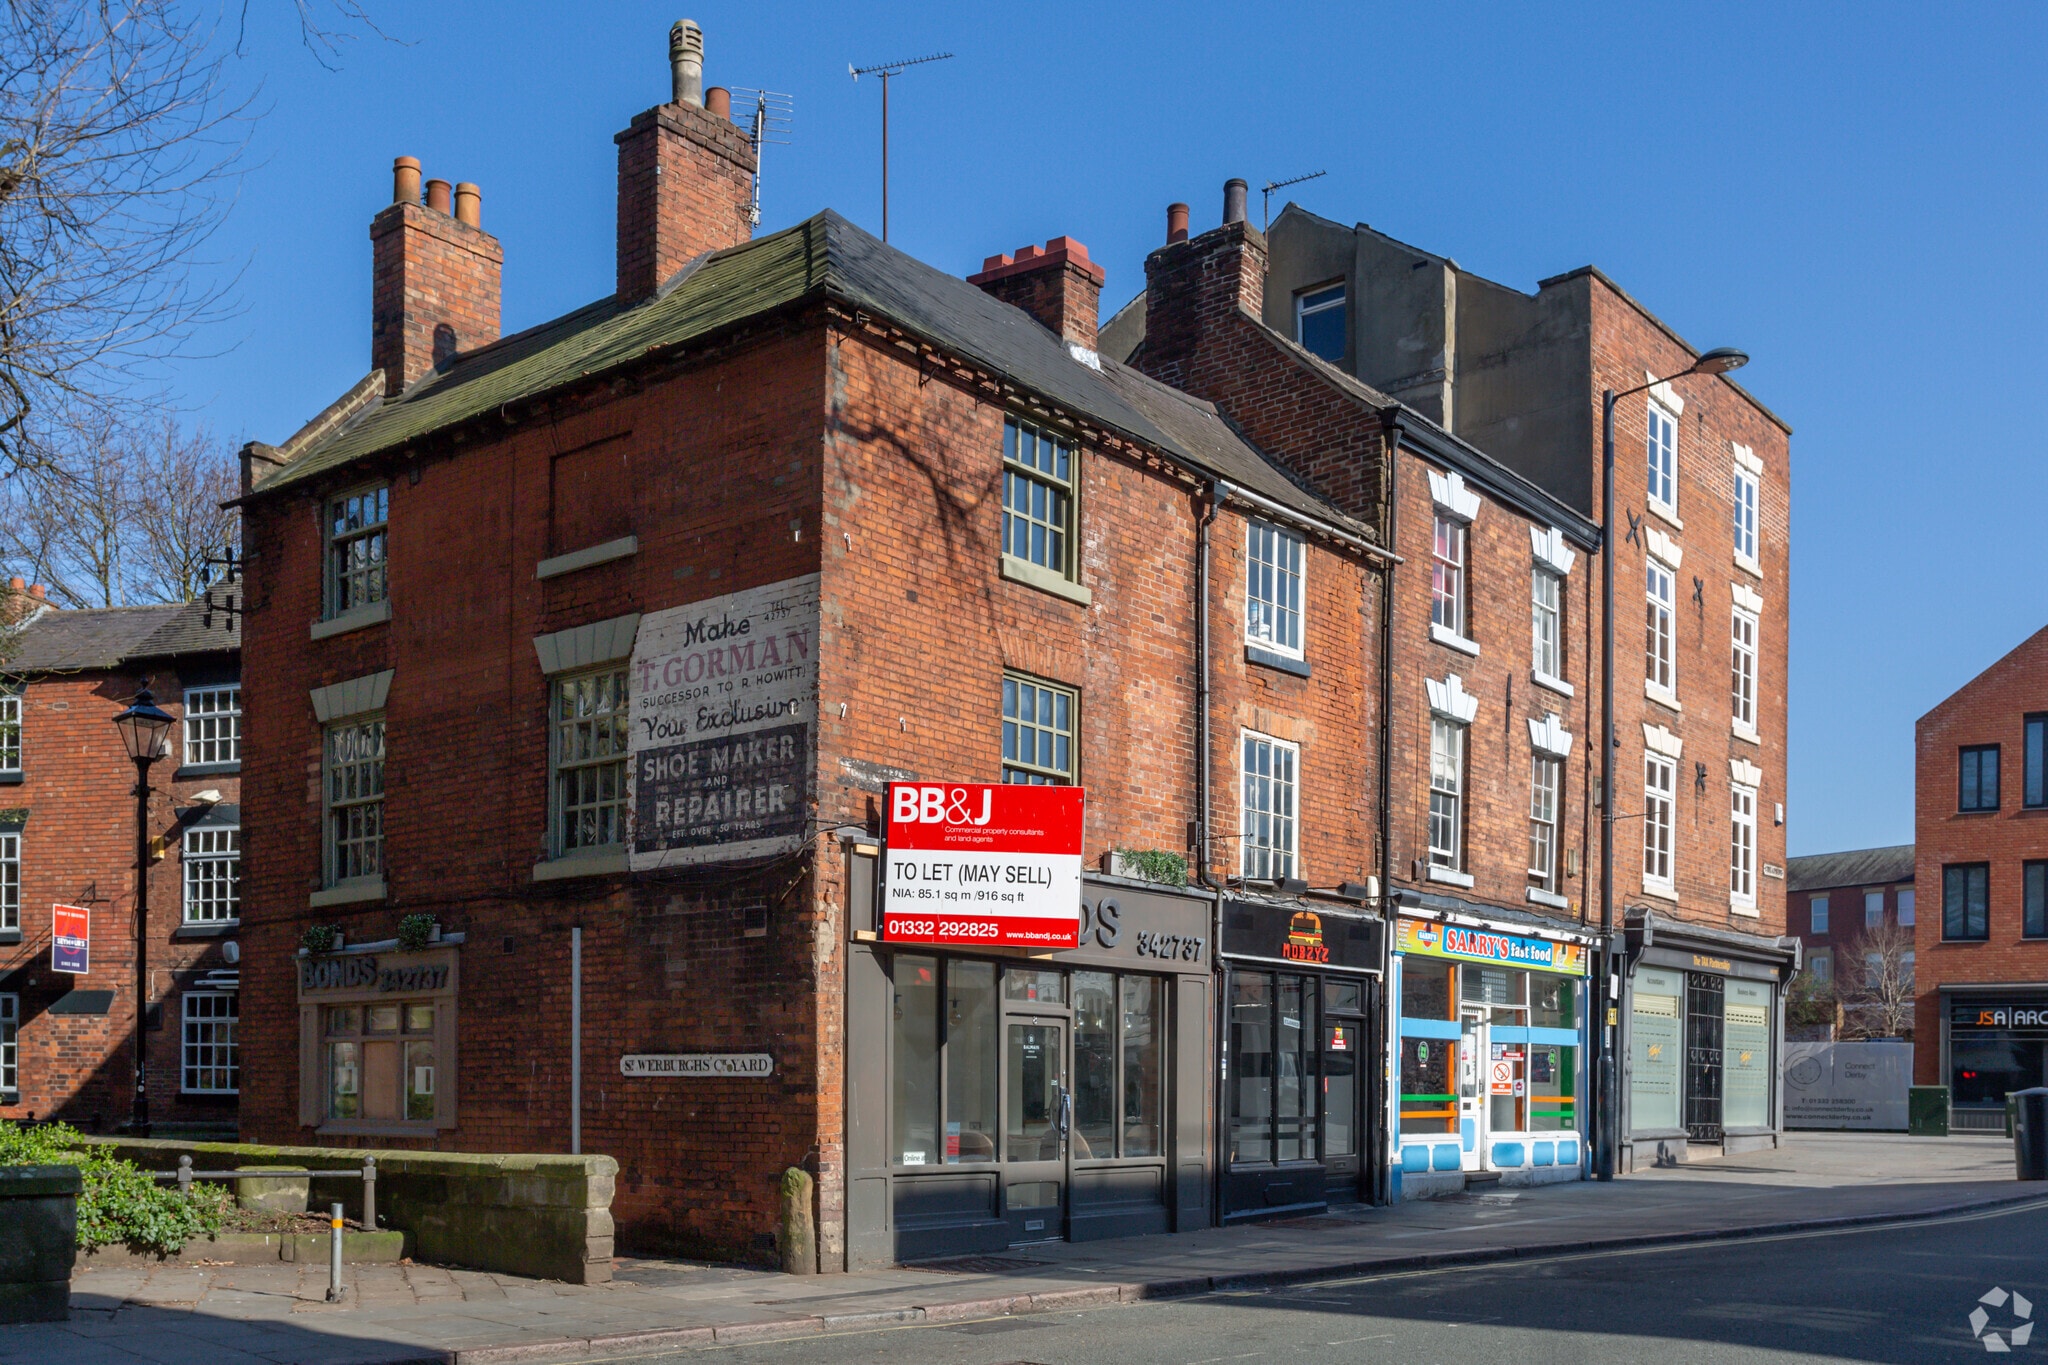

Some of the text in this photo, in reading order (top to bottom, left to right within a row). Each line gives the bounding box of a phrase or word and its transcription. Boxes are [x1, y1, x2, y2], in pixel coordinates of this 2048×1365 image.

[764, 609, 792, 622] 42737
[684, 613, 750, 648] Make
[662, 628, 811, 688] GORMAN
[718, 681, 733, 693] TO
[696, 696, 800, 733] Exclusive
[643, 734, 795, 782] SHOE MAKER
[704, 775, 728, 787] AND
[655, 783, 786, 828] REPAIRER
[893, 786, 992, 826] BB&J
[691, 826, 711, 836] OVER
[720, 824, 730, 833] 50
[735, 820, 761, 830] YEARS
[944, 825, 1044, 837] Commercial property consultants
[957, 835, 971, 843] land
[972, 836, 993, 844] agents
[894, 862, 1052, 889] TO LET (MAY SELL)
[892, 888, 1025, 904] NIA: 85.1 sq m /916 sq ft
[889, 920, 1072, 942] 01332 292825 www.bbandj.co.uk
[1136, 929, 1205, 962] 342737
[1447, 928, 1509, 958] SARRY'S
[1511, 942, 1530, 959] fast
[1531, 944, 1551, 962] food
[301, 956, 377, 989] BONDS
[1709, 957, 1730, 972] Partnership
[1976, 1010, 2006, 1025] JSA
[732, 1058, 768, 1072] YARD
[1845, 1062, 1875, 1070] Connect
[1845, 1071, 1867, 1080] Derby
